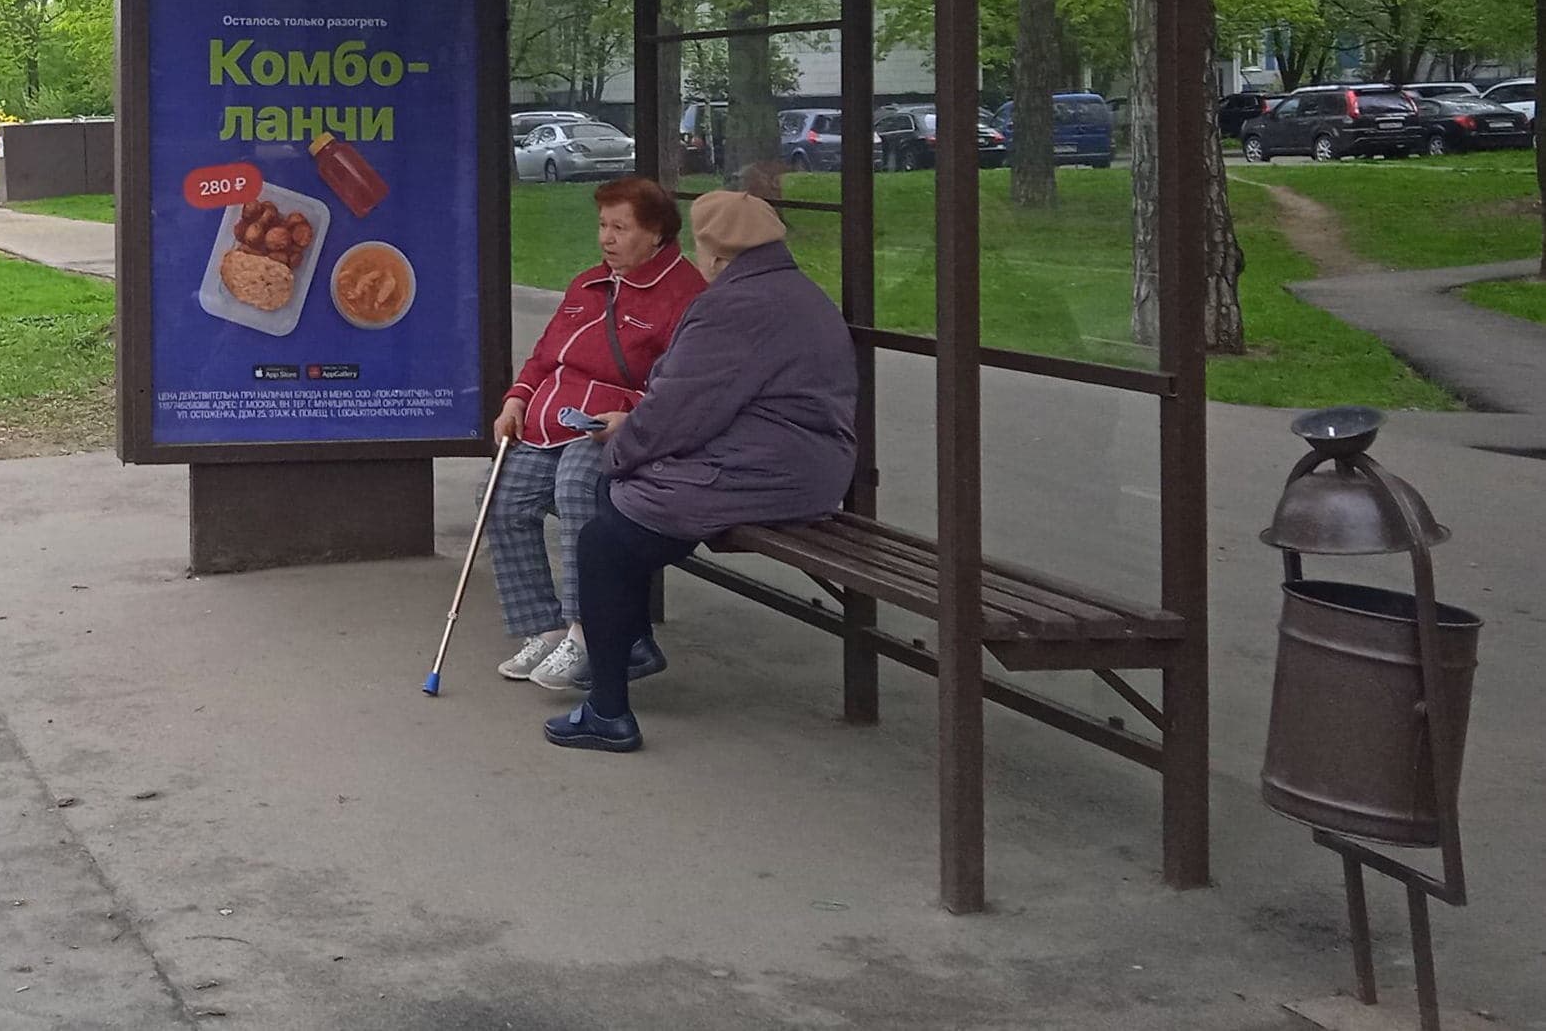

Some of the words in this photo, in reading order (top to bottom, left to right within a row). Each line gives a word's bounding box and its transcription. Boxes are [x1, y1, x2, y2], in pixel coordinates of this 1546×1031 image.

[222, 15, 280, 26] Осталось
[284, 17, 324, 26] только
[327, 18, 388, 29] разогреть
[208, 39, 430, 86] Комбо-
[219, 105, 394, 142] ланчи
[199, 178, 231, 197] 280
